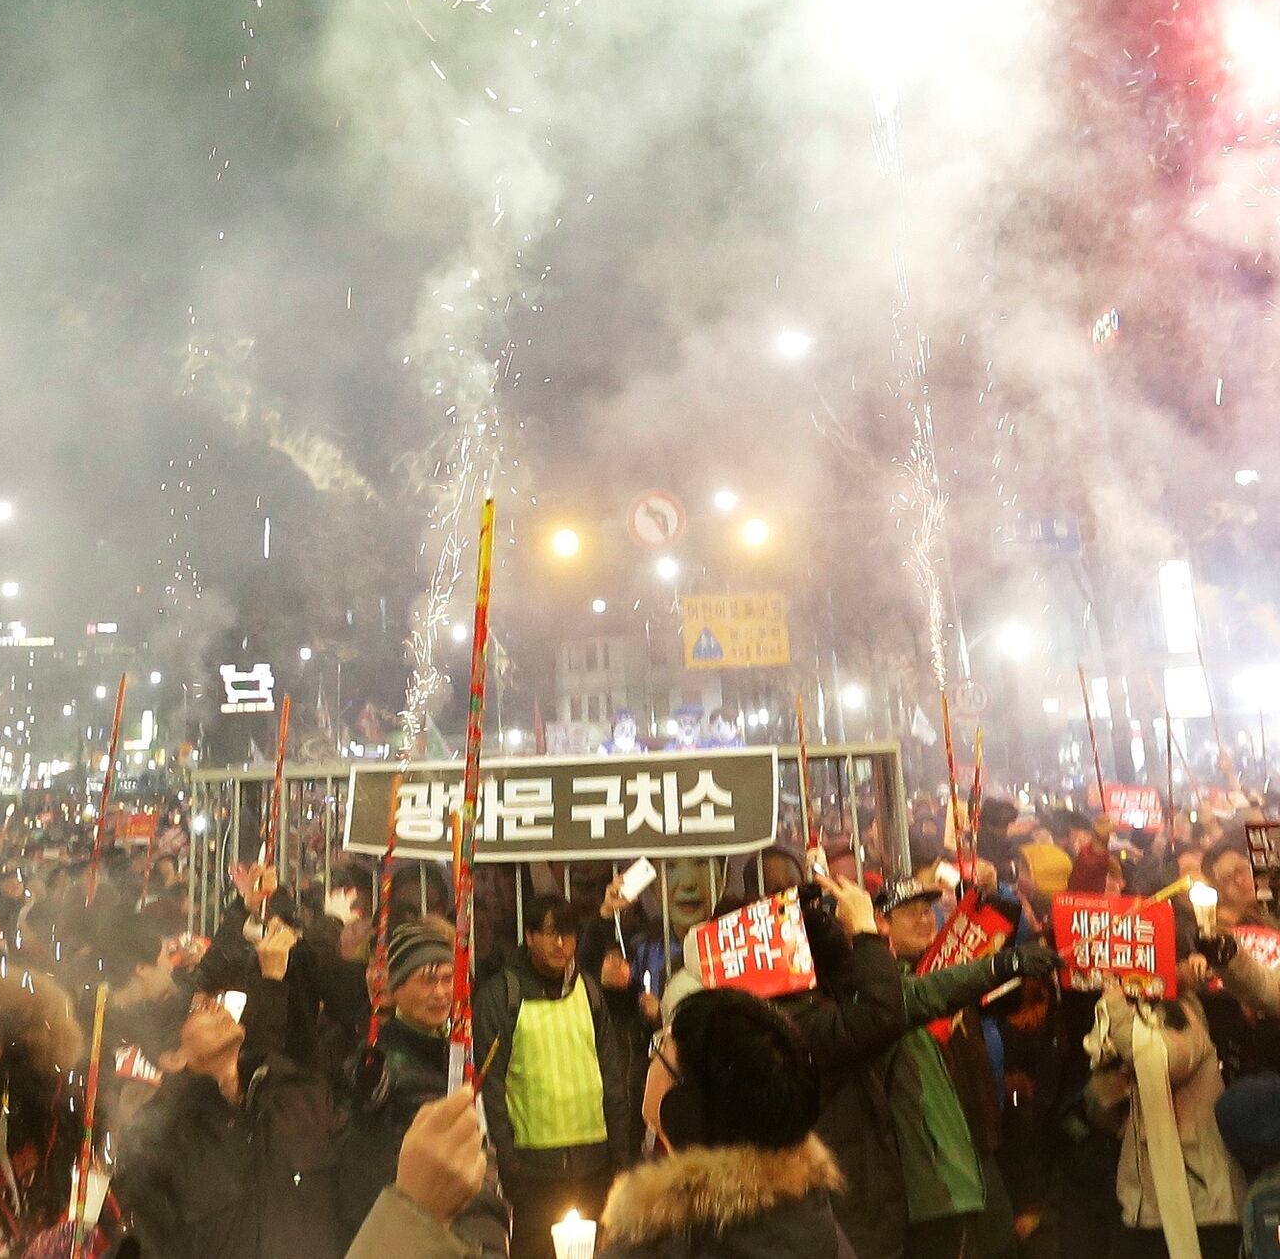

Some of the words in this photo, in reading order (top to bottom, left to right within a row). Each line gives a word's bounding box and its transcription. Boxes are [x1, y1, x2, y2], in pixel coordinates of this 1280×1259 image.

[571, 769, 735, 840] 구치소
[1071, 909, 1155, 944] 새해에는
[1072, 939, 1156, 975] 정권교체
